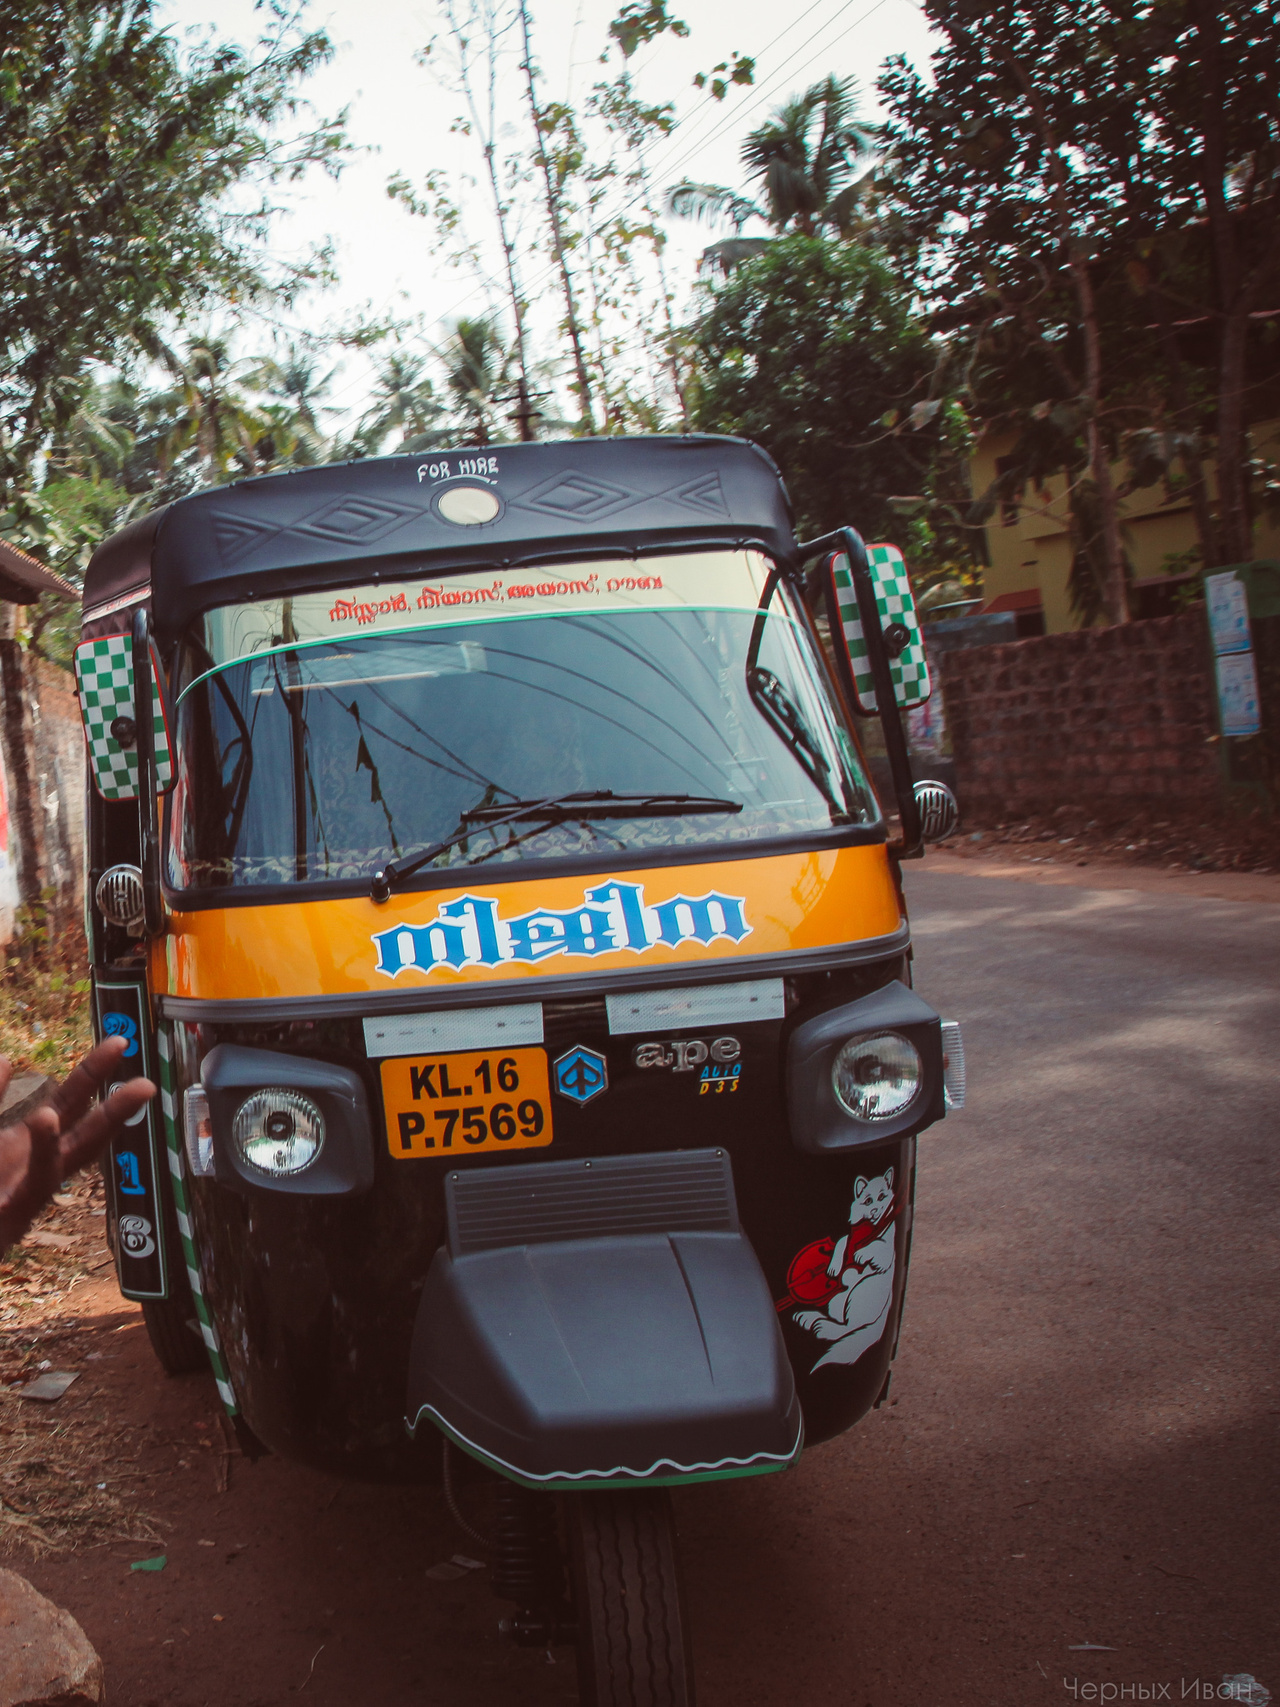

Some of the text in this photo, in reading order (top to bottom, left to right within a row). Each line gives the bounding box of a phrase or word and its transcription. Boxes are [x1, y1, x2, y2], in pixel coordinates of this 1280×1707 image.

[417, 457, 499, 483] FOR HIRE
[635, 1036, 741, 1073] ape
[701, 1064, 742, 1078] AUTO
[408, 1057, 520, 1101] KL.16
[397, 1100, 544, 1151] P.7569
